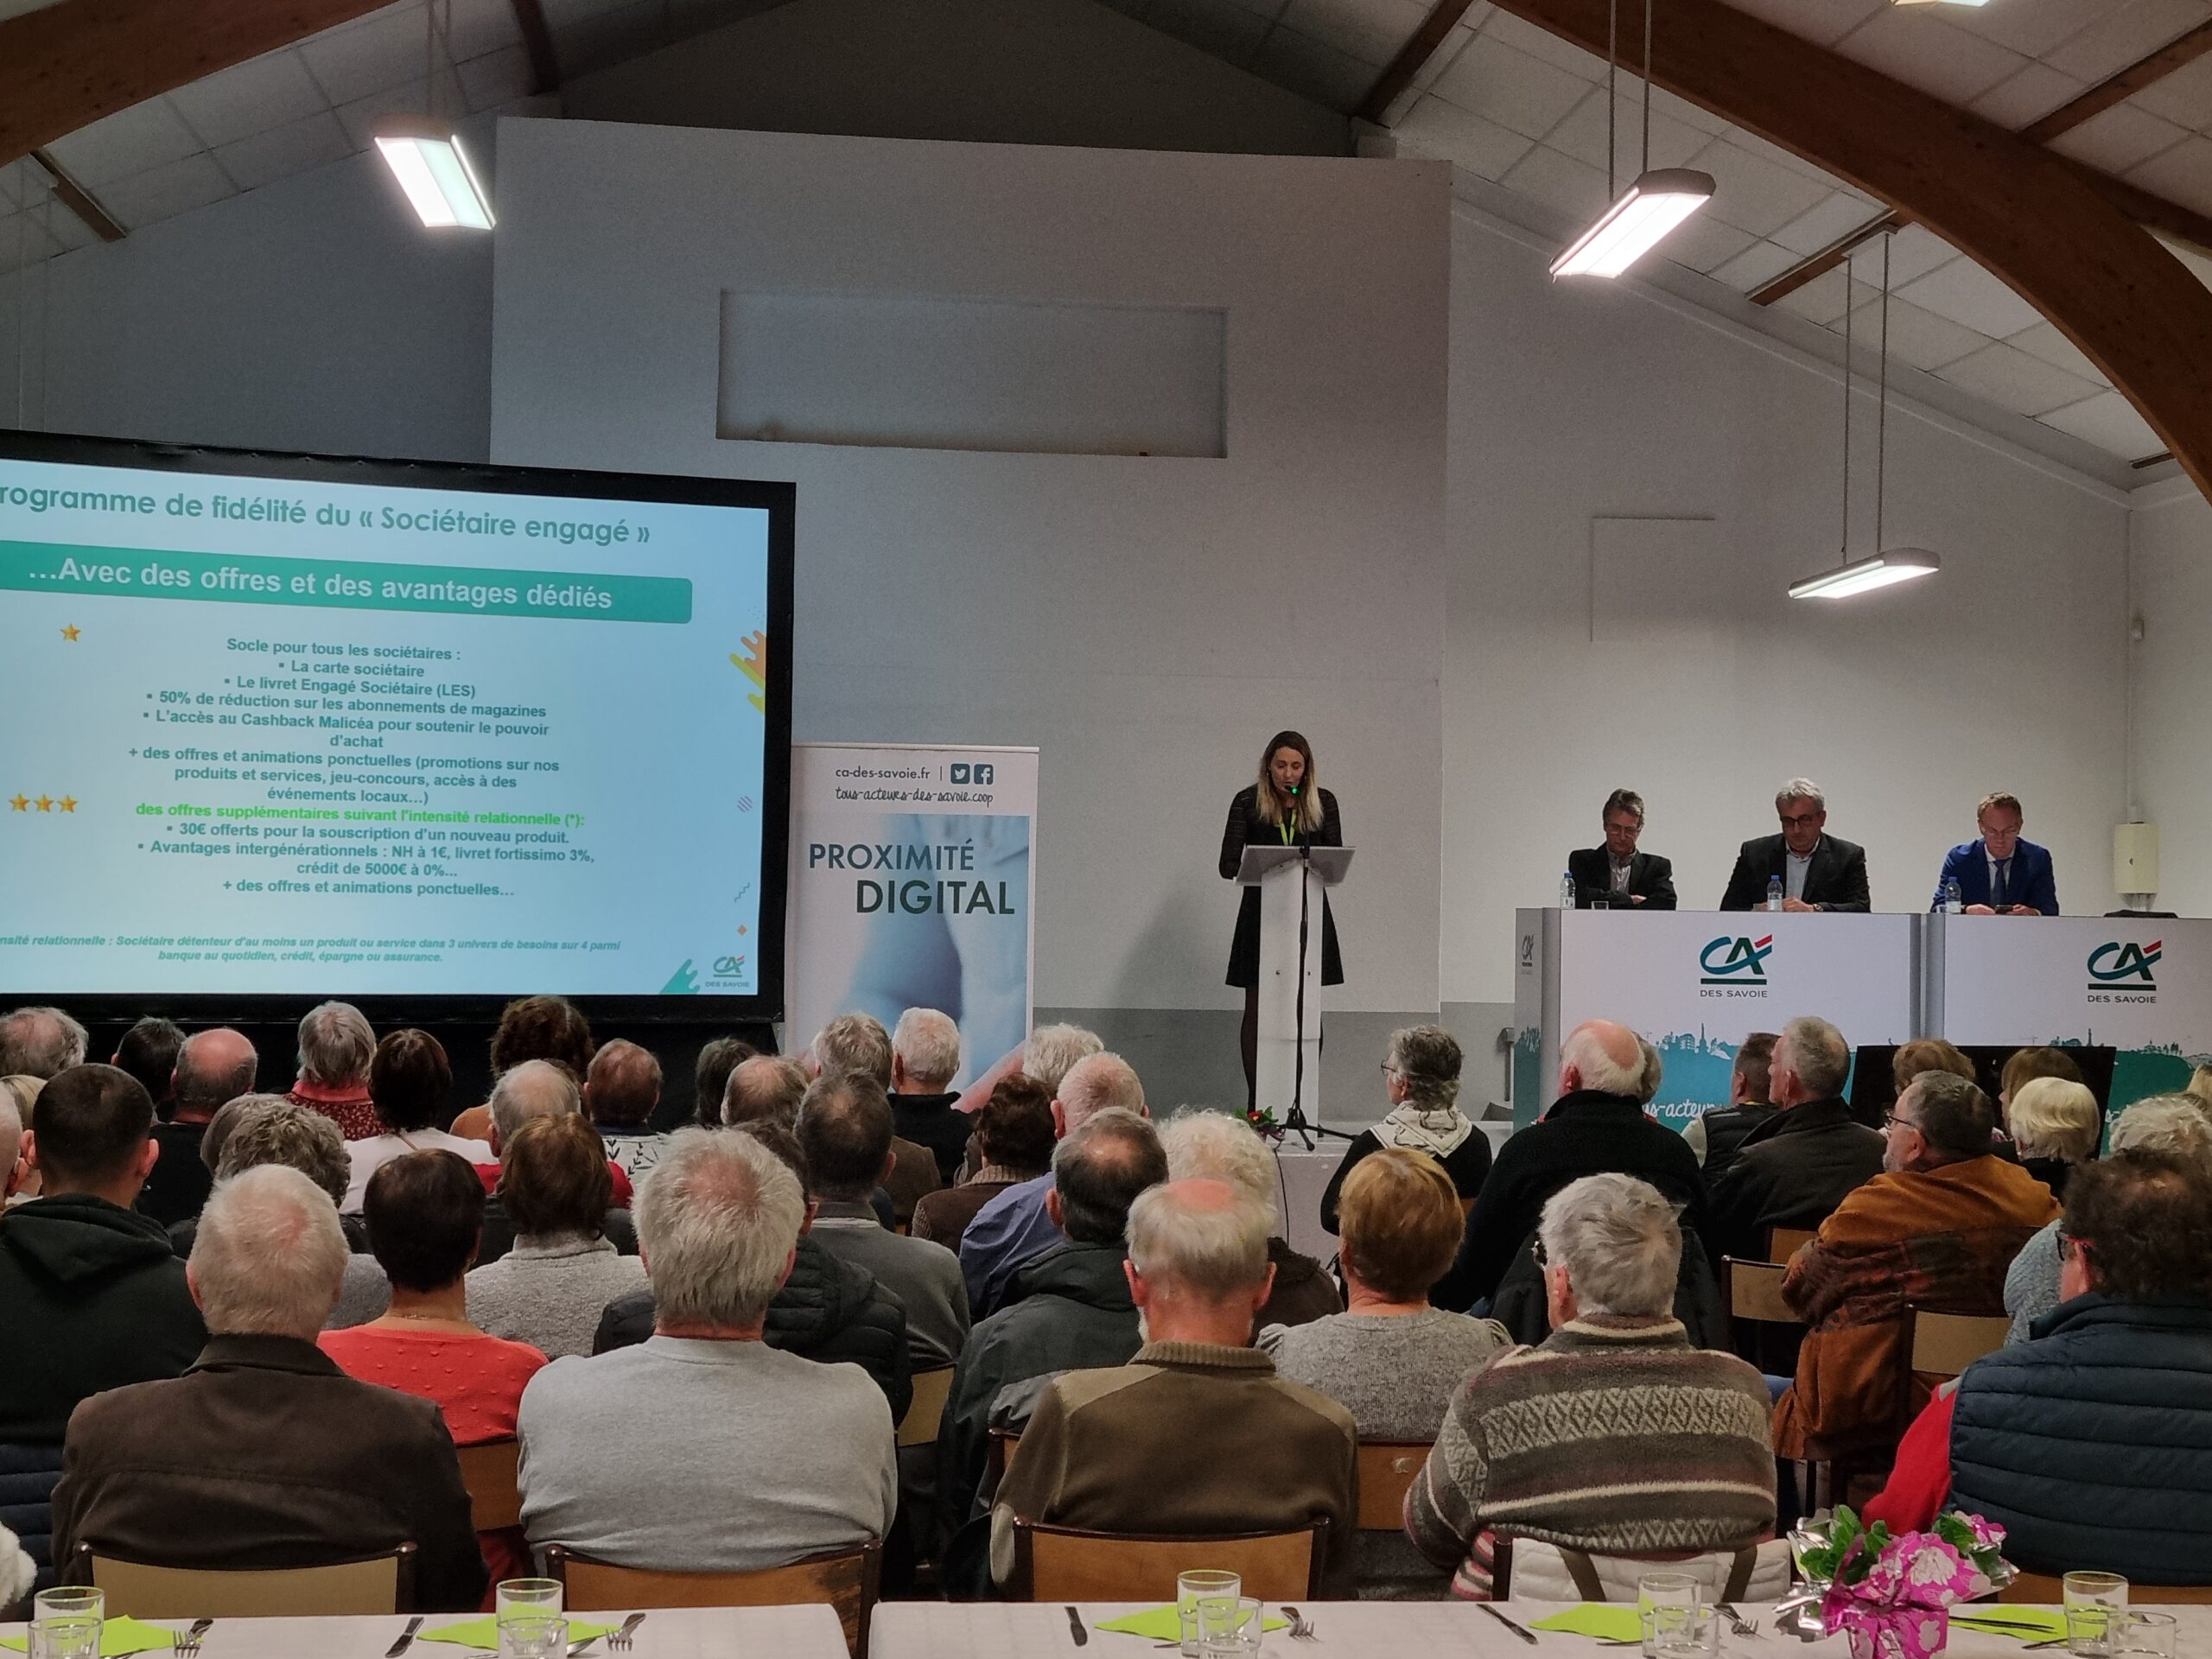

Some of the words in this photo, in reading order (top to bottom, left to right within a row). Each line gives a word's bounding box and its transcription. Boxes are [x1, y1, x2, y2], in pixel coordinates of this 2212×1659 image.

[0, 486, 156, 513] rogramme
[166, 493, 203, 517] de
[212, 495, 306, 524] fidélité
[316, 503, 350, 526] du
[381, 507, 516, 536] Sociétaire
[525, 519, 629, 546] engagé
[141, 563, 191, 587] des
[201, 567, 281, 592] offres
[290, 573, 315, 594] et
[325, 574, 372, 596] des
[382, 581, 518, 607] avantages
[527, 584, 612, 608] dédiés
[227, 639, 269, 652] Socle
[273, 644, 308, 655] pour
[312, 643, 343, 655] tous
[348, 644, 369, 656] les
[373, 645, 452, 659] sociétaires
[292, 660, 308, 672] La
[314, 662, 350, 674] carte
[354, 664, 424, 677] sociétaire
[238, 676, 255, 688] Le
[260, 677, 296, 690] livret
[302, 678, 356, 695] Engagé
[360, 681, 433, 695] Sociétaire
[437, 684, 475, 700] (LES)
[160, 691, 191, 704] 50%
[196, 692, 213, 704] de
[219, 693, 289, 708] réduction
[294, 699, 318, 709] sur
[322, 697, 343, 709] les
[348, 699, 446, 714] abonnements
[450, 702, 467, 715] de
[472, 704, 546, 718] magazines
[219, 715, 237, 724] au
[242, 713, 315, 728] Cashback
[319, 716, 373, 729] Malicéa
[378, 721, 412, 733] pour
[416, 721, 475, 733] soutenir
[479, 721, 491, 734] le
[495, 723, 550, 736] pouvoir
[143, 747, 170, 759] des
[175, 748, 219, 760] offres
[223, 750, 238, 761] et
[241, 750, 323, 764] animations
[328, 754, 411, 767] ponctuelles
[416, 756, 503, 770] (promotions
[506, 761, 531, 770] sur
[534, 762, 559, 771] nos
[175, 767, 238, 781] produits
[242, 769, 256, 780] et
[260, 770, 326, 785] services,
[329, 771, 429, 787] jeu-concours,
[434, 774, 475, 786] accès
[480, 775, 487, 787] à
[492, 776, 517, 787] des
[836, 766, 930, 779] ca-des-savoie.fr
[268, 786, 356, 801] événements
[136, 803, 163, 815] des
[168, 804, 212, 817] offres
[217, 805, 340, 820] supplémentaires
[344, 809, 397, 821] suivant
[474, 812, 562, 825] relationnelle
[180, 823, 206, 835] 30€
[211, 823, 259, 836] offerts
[264, 828, 298, 839] pour
[302, 825, 315, 837] la
[319, 827, 410, 842] souscription
[450, 832, 511, 842] nouveau
[516, 831, 569, 845] produit.
[150, 841, 231, 856] Avantages
[236, 842, 378, 857] intergénérationnels
[392, 846, 413, 857] NH
[417, 846, 425, 857] à
[431, 847, 450, 861] 1€,
[455, 847, 491, 859] livret
[495, 848, 566, 861] fortissimo
[569, 849, 594, 863] 3%,
[810, 838, 974, 871] PROXIMITÉ
[297, 861, 339, 874] crédit
[343, 862, 360, 874] de
[365, 863, 407, 875] 5000€
[410, 863, 419, 875] à
[237, 879, 263, 892] des
[268, 880, 310, 892] offres
[315, 880, 329, 893] et
[333, 881, 412, 893] animations
[857, 880, 1014, 914] DIGITAL
[32, 936, 105, 945] relationnelle
[116, 936, 175, 946] Sociétaire
[177, 936, 233, 946] détenteur
[262, 938, 297, 946] moins
[316, 938, 358, 949] produit
[376, 938, 416, 948] service
[419, 938, 446, 948] dans
[448, 938, 455, 948] 3
[457, 939, 499, 949] univers
[500, 940, 514, 949] de
[516, 940, 559, 950] besoins
[581, 941, 588, 950] 4
[589, 941, 621, 952] parmi
[1700, 934, 1772, 975] CA
[157, 950, 201, 963] banque
[221, 950, 277, 963] quotidien,
[281, 950, 315, 963] crédit,
[319, 950, 365, 963] épargne
[2088, 940, 2161, 981] CA
[2088, 995, 2110, 1003] DES
[2114, 995, 2157, 1004] SAVOIE
